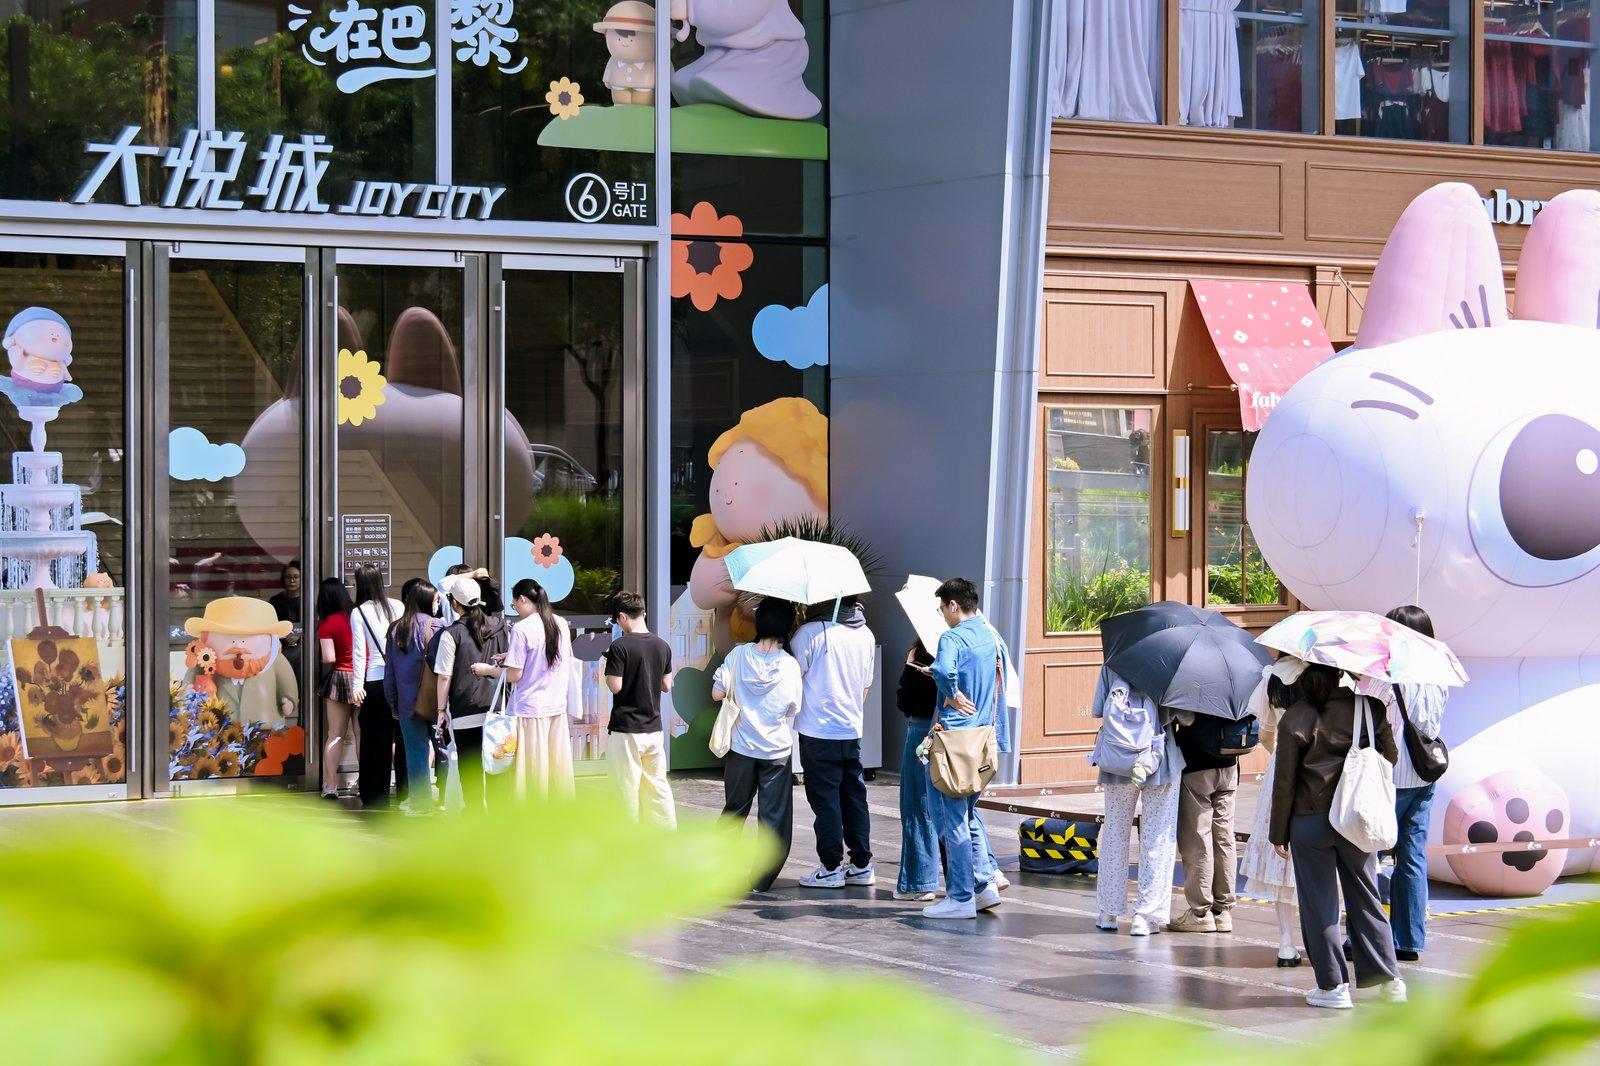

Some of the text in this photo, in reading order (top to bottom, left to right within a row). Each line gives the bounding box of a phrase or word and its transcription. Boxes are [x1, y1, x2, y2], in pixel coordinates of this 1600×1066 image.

[310, 0, 519, 66] 在巴黎
[70, 125, 334, 213] 大悦城
[612, 181, 647, 201] 号门
[612, 203, 647, 218] GATE
